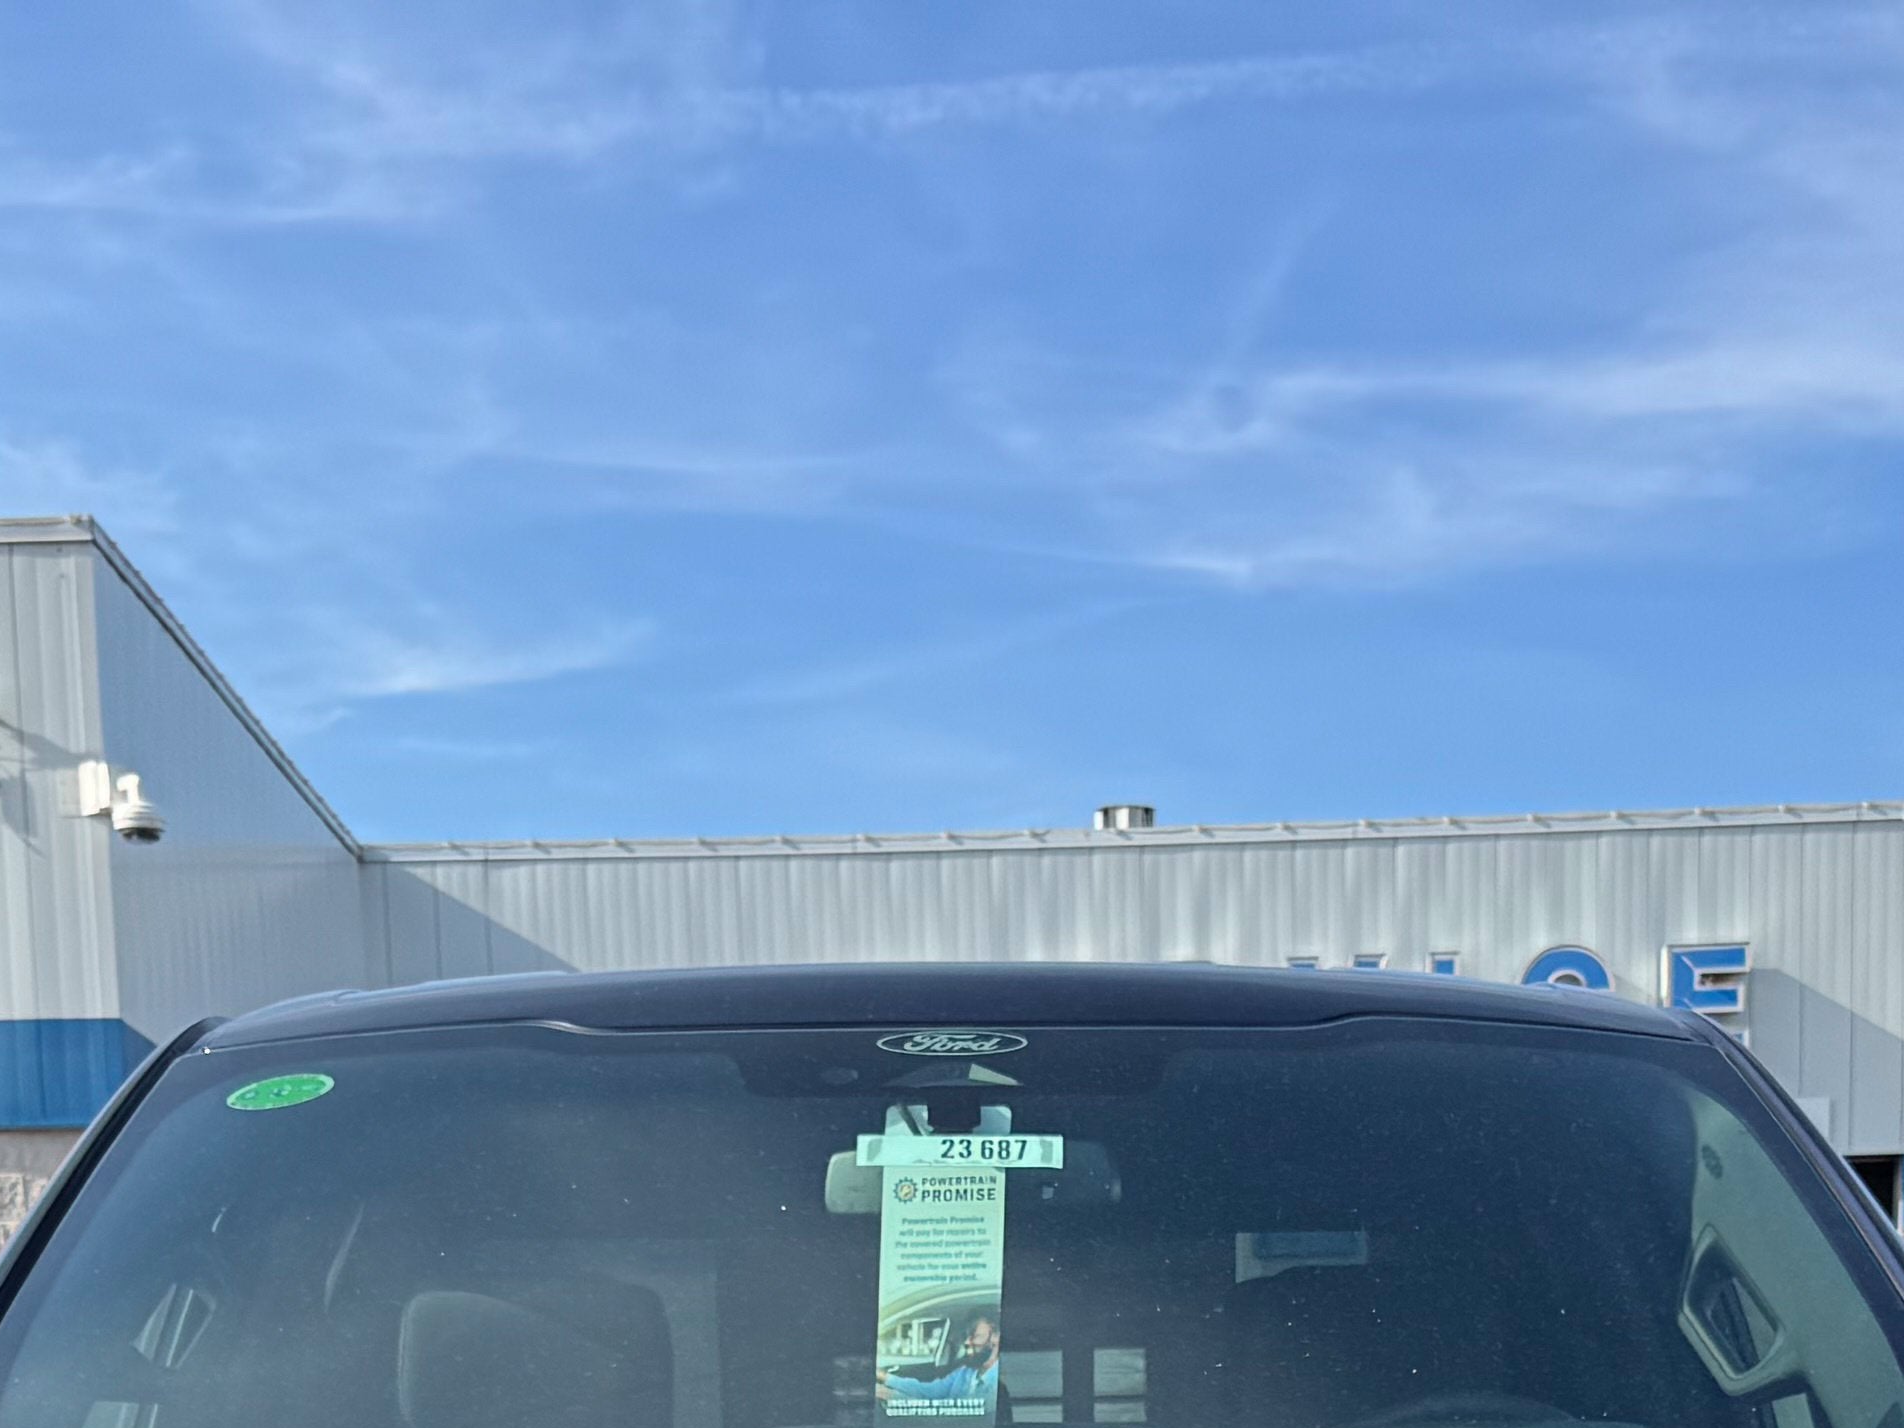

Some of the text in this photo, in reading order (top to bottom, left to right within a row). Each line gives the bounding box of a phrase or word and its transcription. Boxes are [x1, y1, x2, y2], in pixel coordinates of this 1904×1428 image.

[903, 1033, 1002, 1051] Ford
[921, 1175, 997, 1186] POWERTRAIN
[921, 1187, 997, 1203] PROMISE
